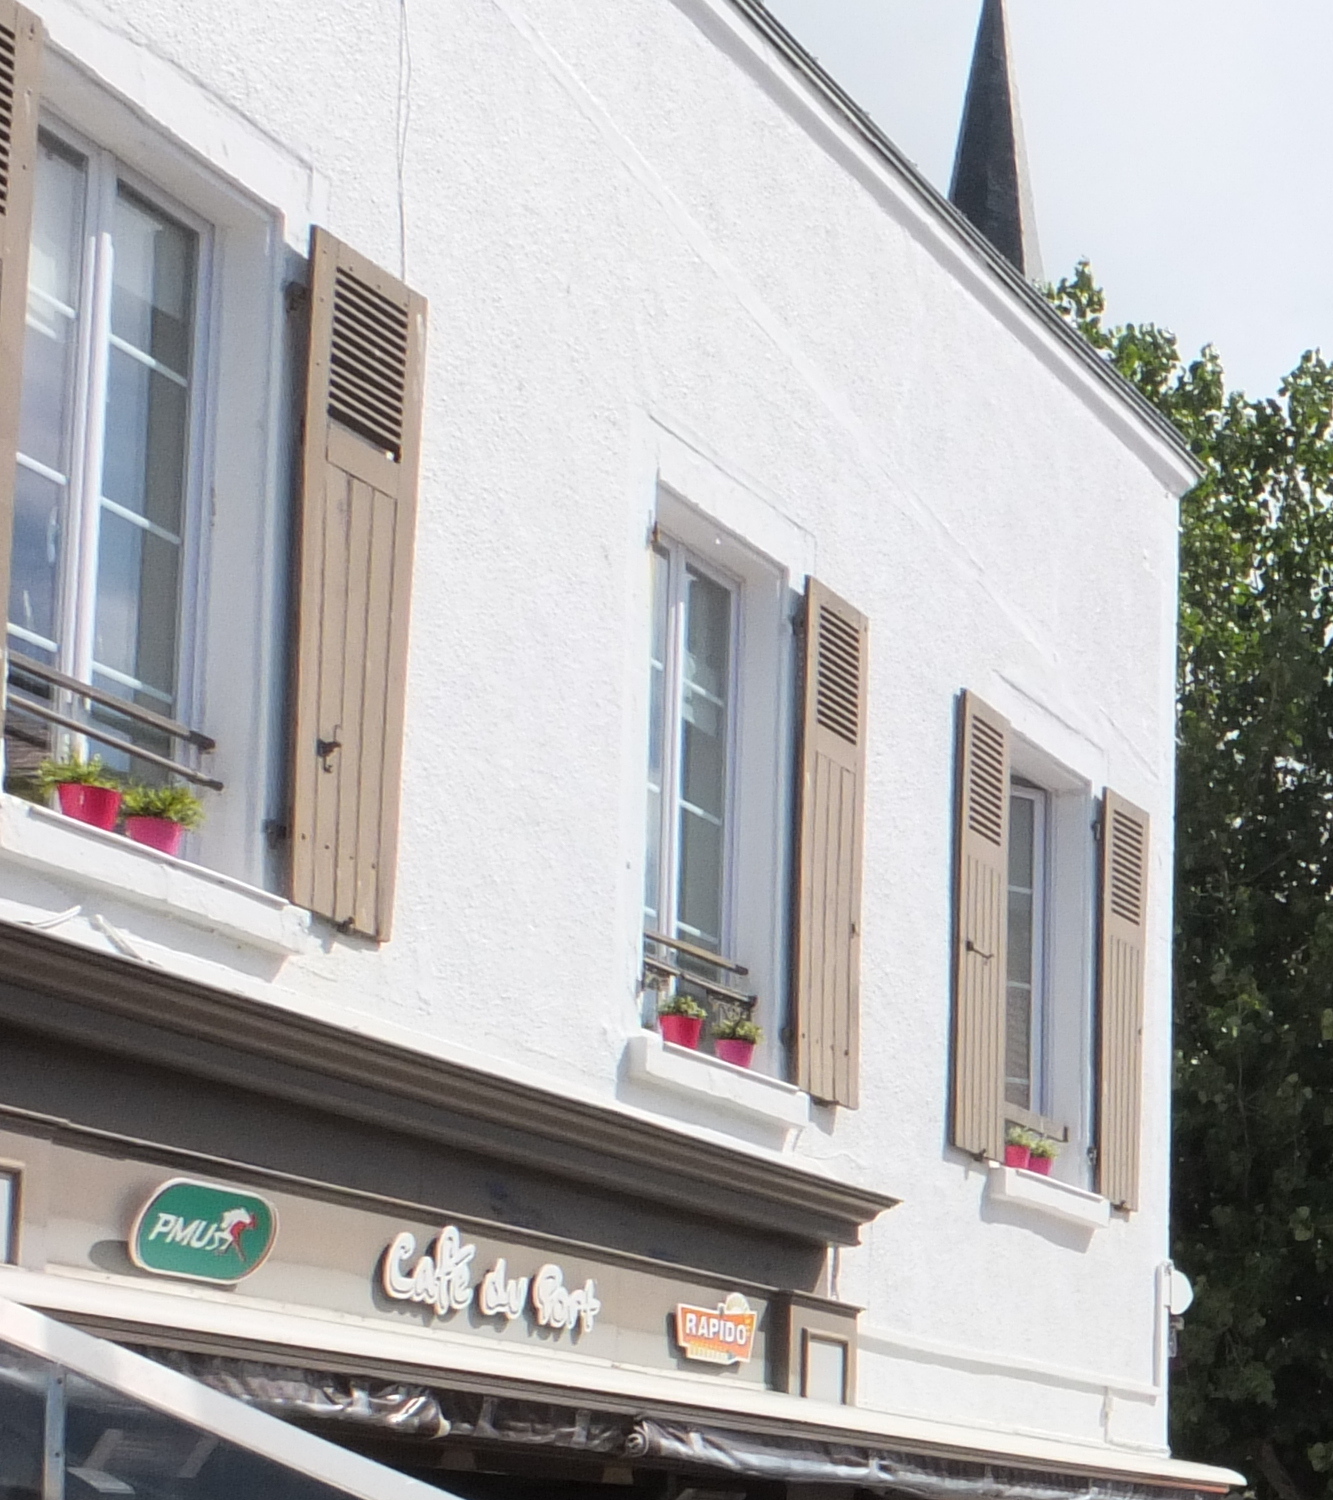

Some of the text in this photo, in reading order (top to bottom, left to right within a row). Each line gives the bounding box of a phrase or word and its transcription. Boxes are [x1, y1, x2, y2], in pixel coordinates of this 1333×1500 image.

[148, 1212, 217, 1252] PMU
[382, 1224, 602, 1333] Café du Port
[685, 1312, 747, 1346] RAPIDO
